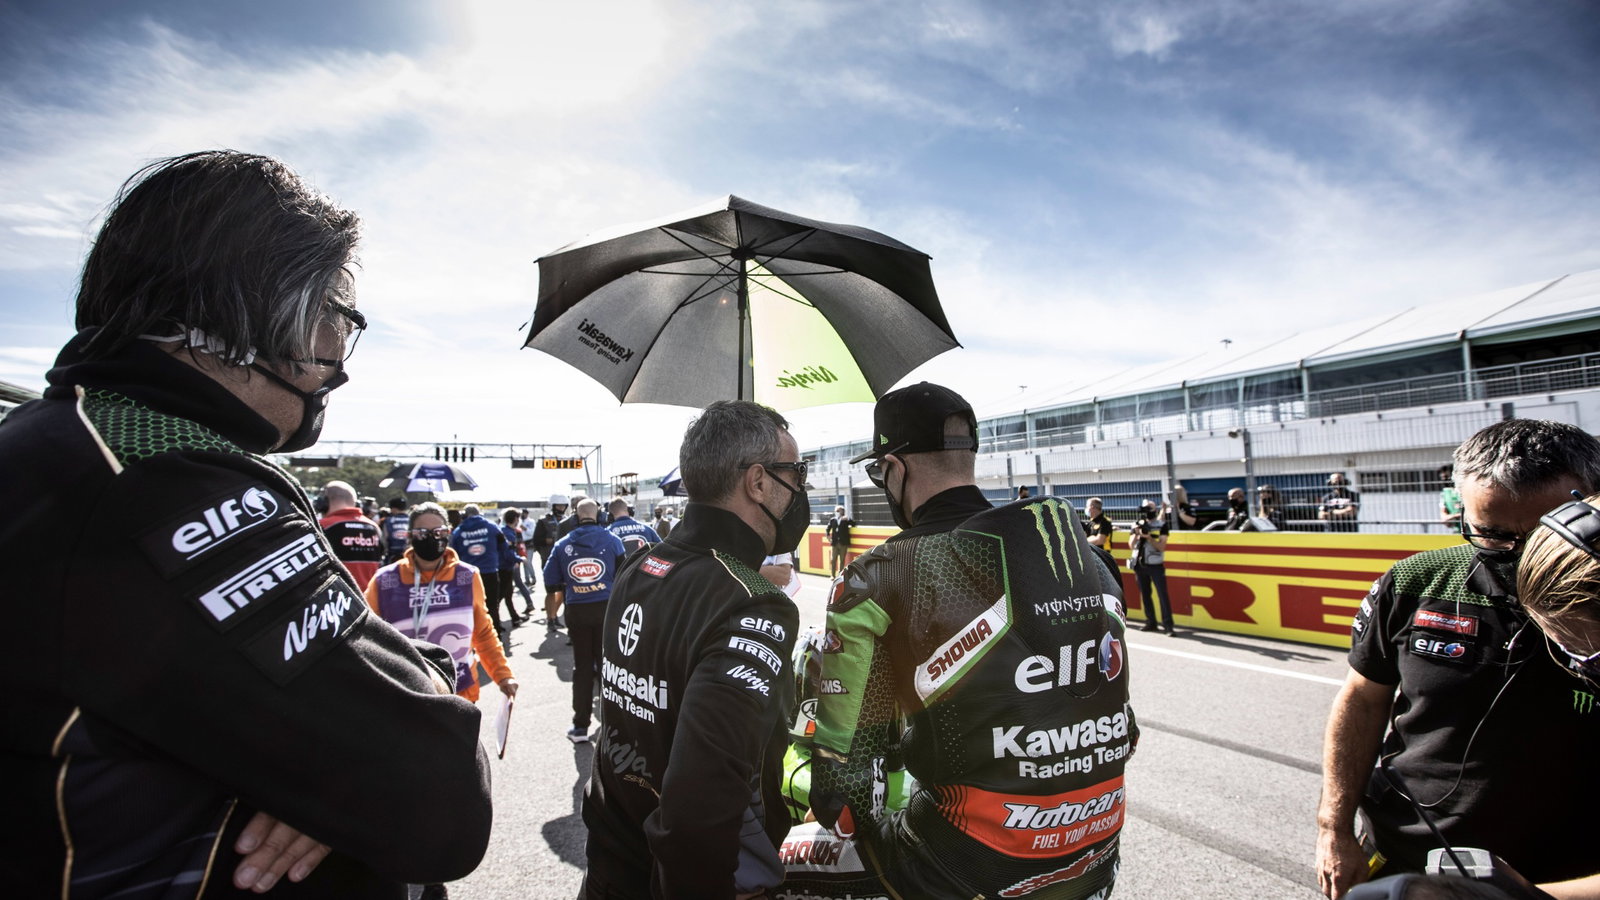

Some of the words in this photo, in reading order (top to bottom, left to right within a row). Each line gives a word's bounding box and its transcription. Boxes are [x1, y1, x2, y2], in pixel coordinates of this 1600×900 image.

[172, 499, 239, 553] elf
[199, 533, 329, 622] PIRELLI
[574, 566, 597, 575] PATA
[740, 617, 771, 632] elf
[1034, 596, 1103, 617] MONSTER
[1051, 612, 1099, 626] ENERGY
[284, 589, 352, 662] Ninja
[728, 636, 783, 676] PIRELLI
[927, 618, 993, 681] SHOWA
[1414, 639, 1446, 653] elf
[601, 656, 668, 710] awasaki
[726, 665, 769, 697] Ninja
[1015, 640, 1096, 693] elf
[602, 684, 624, 709] cing
[624, 695, 655, 724] Team
[1019, 753, 1093, 779] Racing
[1032, 833, 1060, 850] FUEL
[1064, 824, 1089, 846] YOUR
